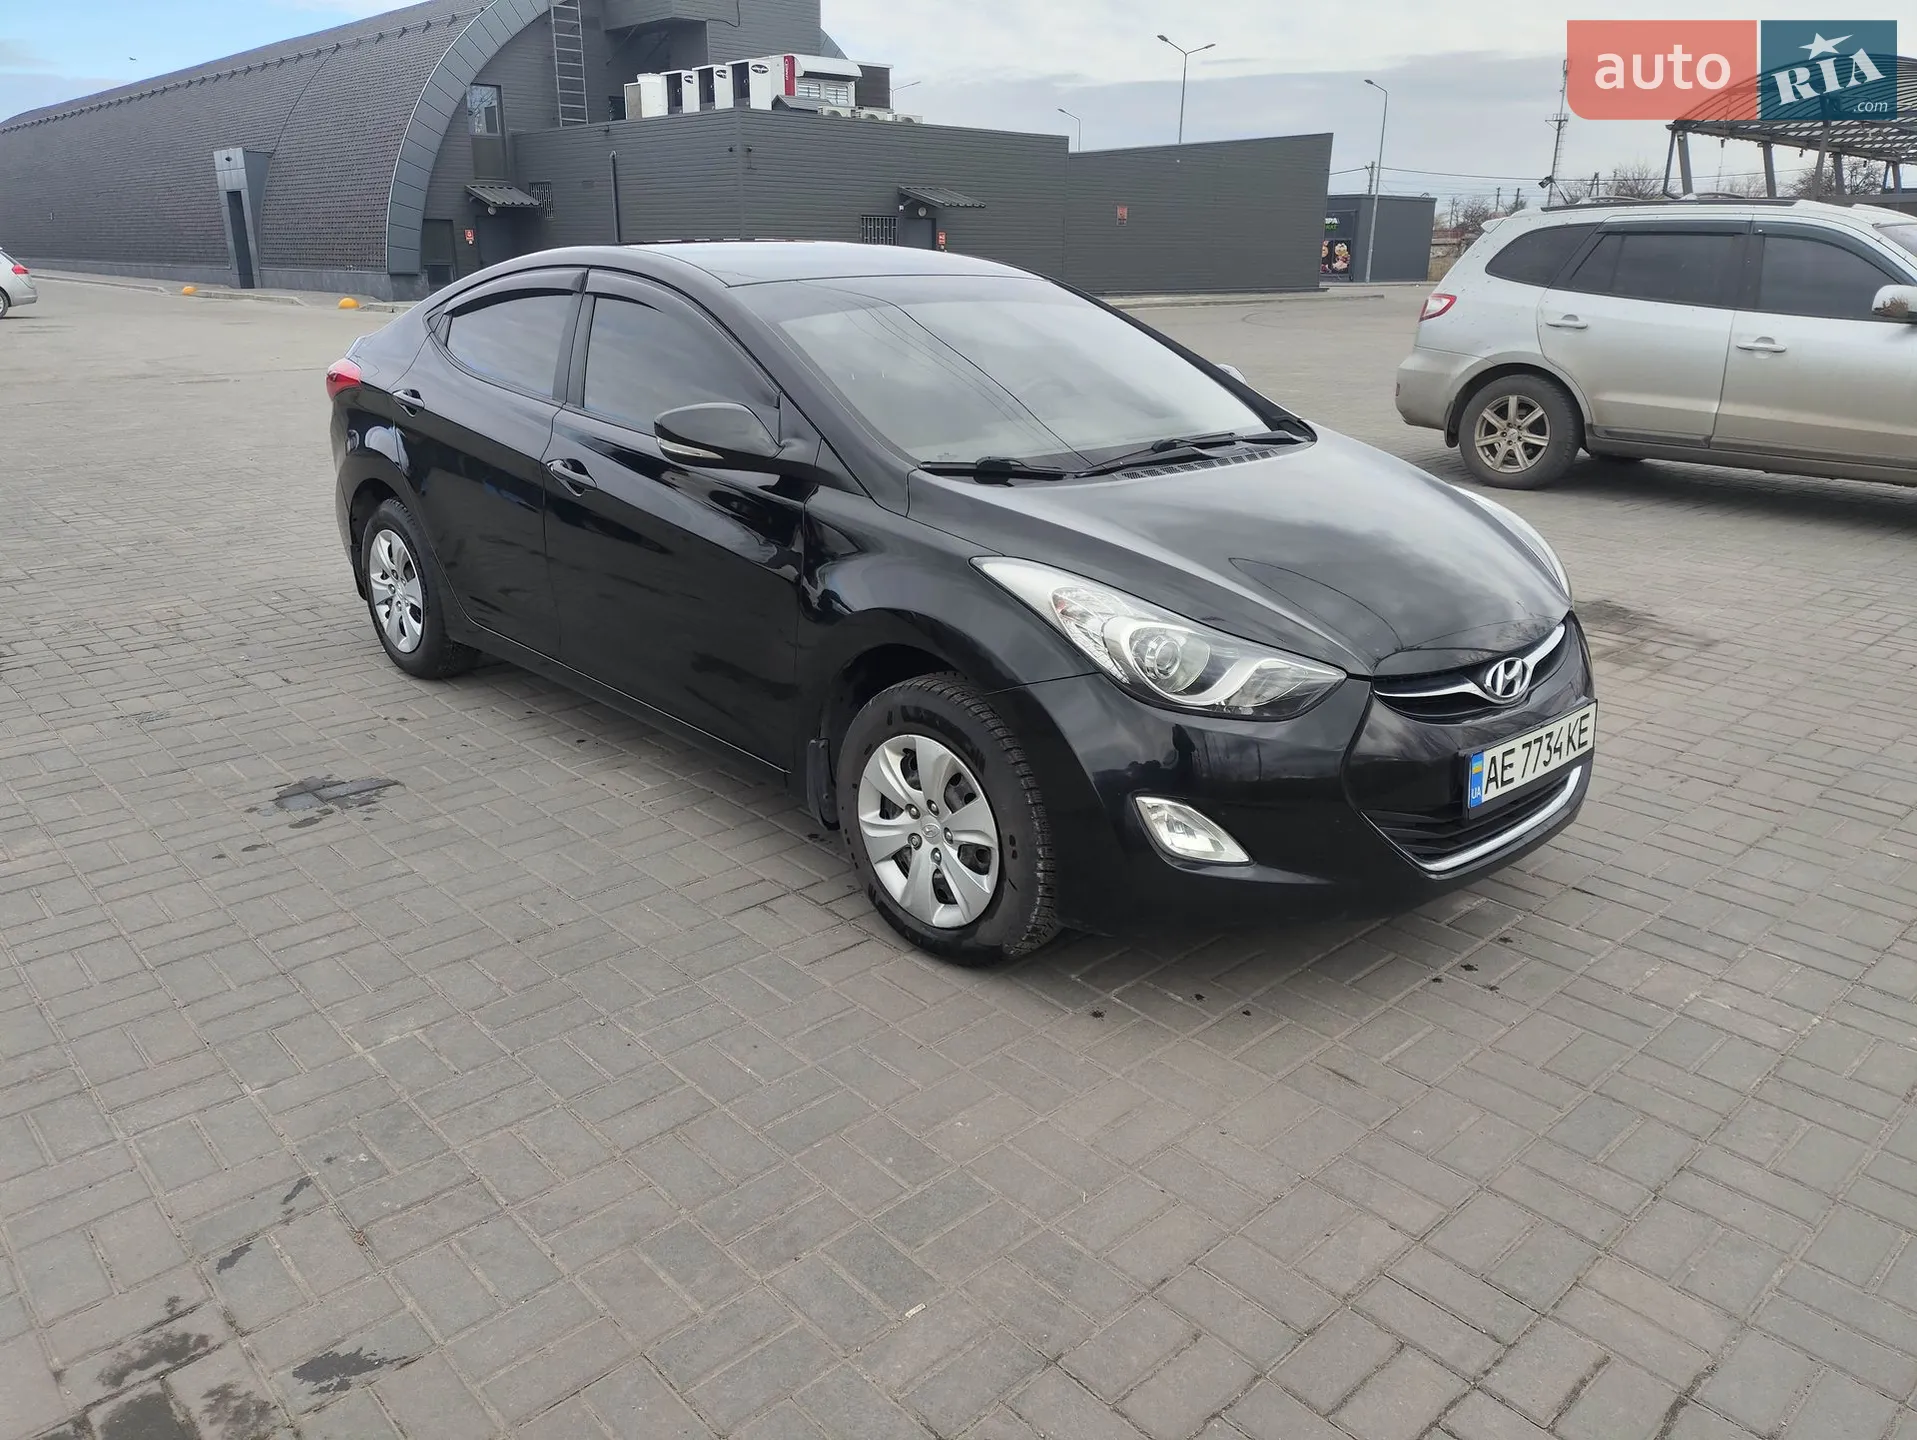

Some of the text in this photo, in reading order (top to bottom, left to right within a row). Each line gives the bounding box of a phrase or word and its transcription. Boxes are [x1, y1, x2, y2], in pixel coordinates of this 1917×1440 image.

[1484, 712, 1590, 795] AE 7734 KE
[1471, 786, 1482, 799] UA
